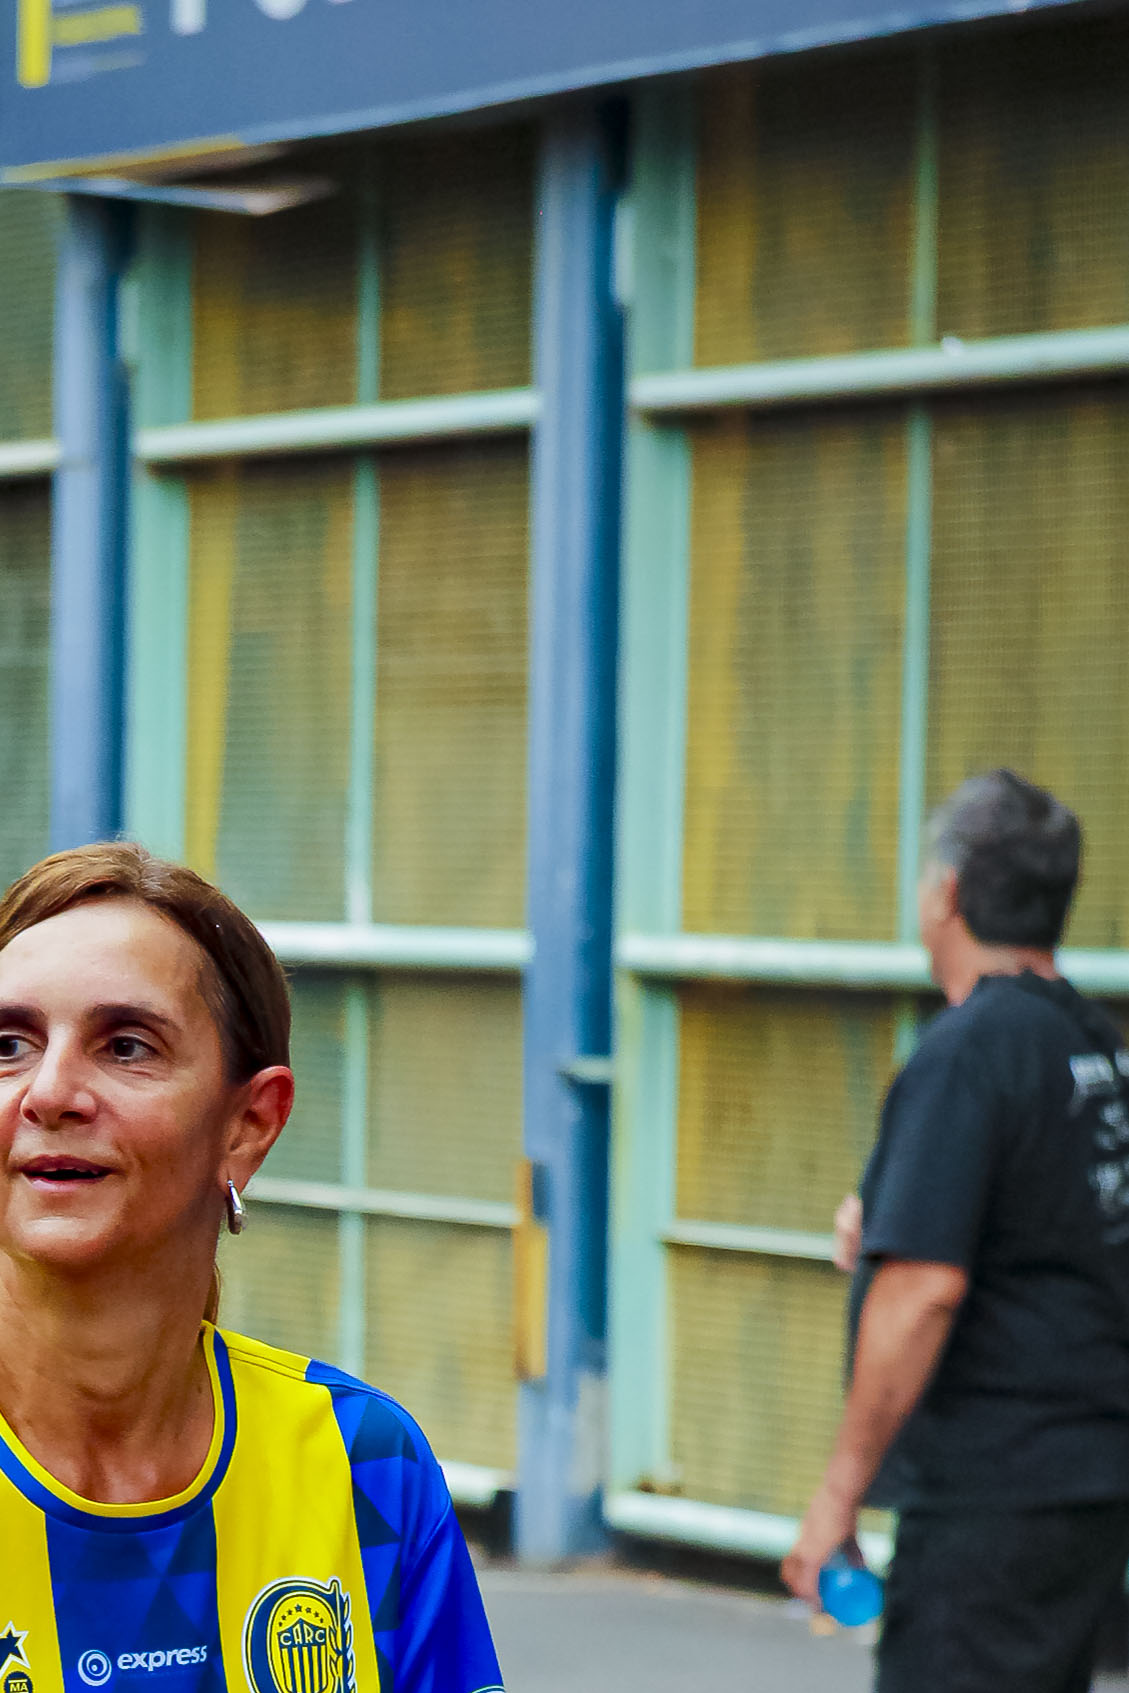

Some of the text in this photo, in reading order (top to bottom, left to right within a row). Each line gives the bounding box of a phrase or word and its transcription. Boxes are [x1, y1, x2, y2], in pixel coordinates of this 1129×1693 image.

[279, 1622, 326, 1646] CARC
[116, 1644, 208, 1672] express
[9, 1682, 29, 1693] MA
